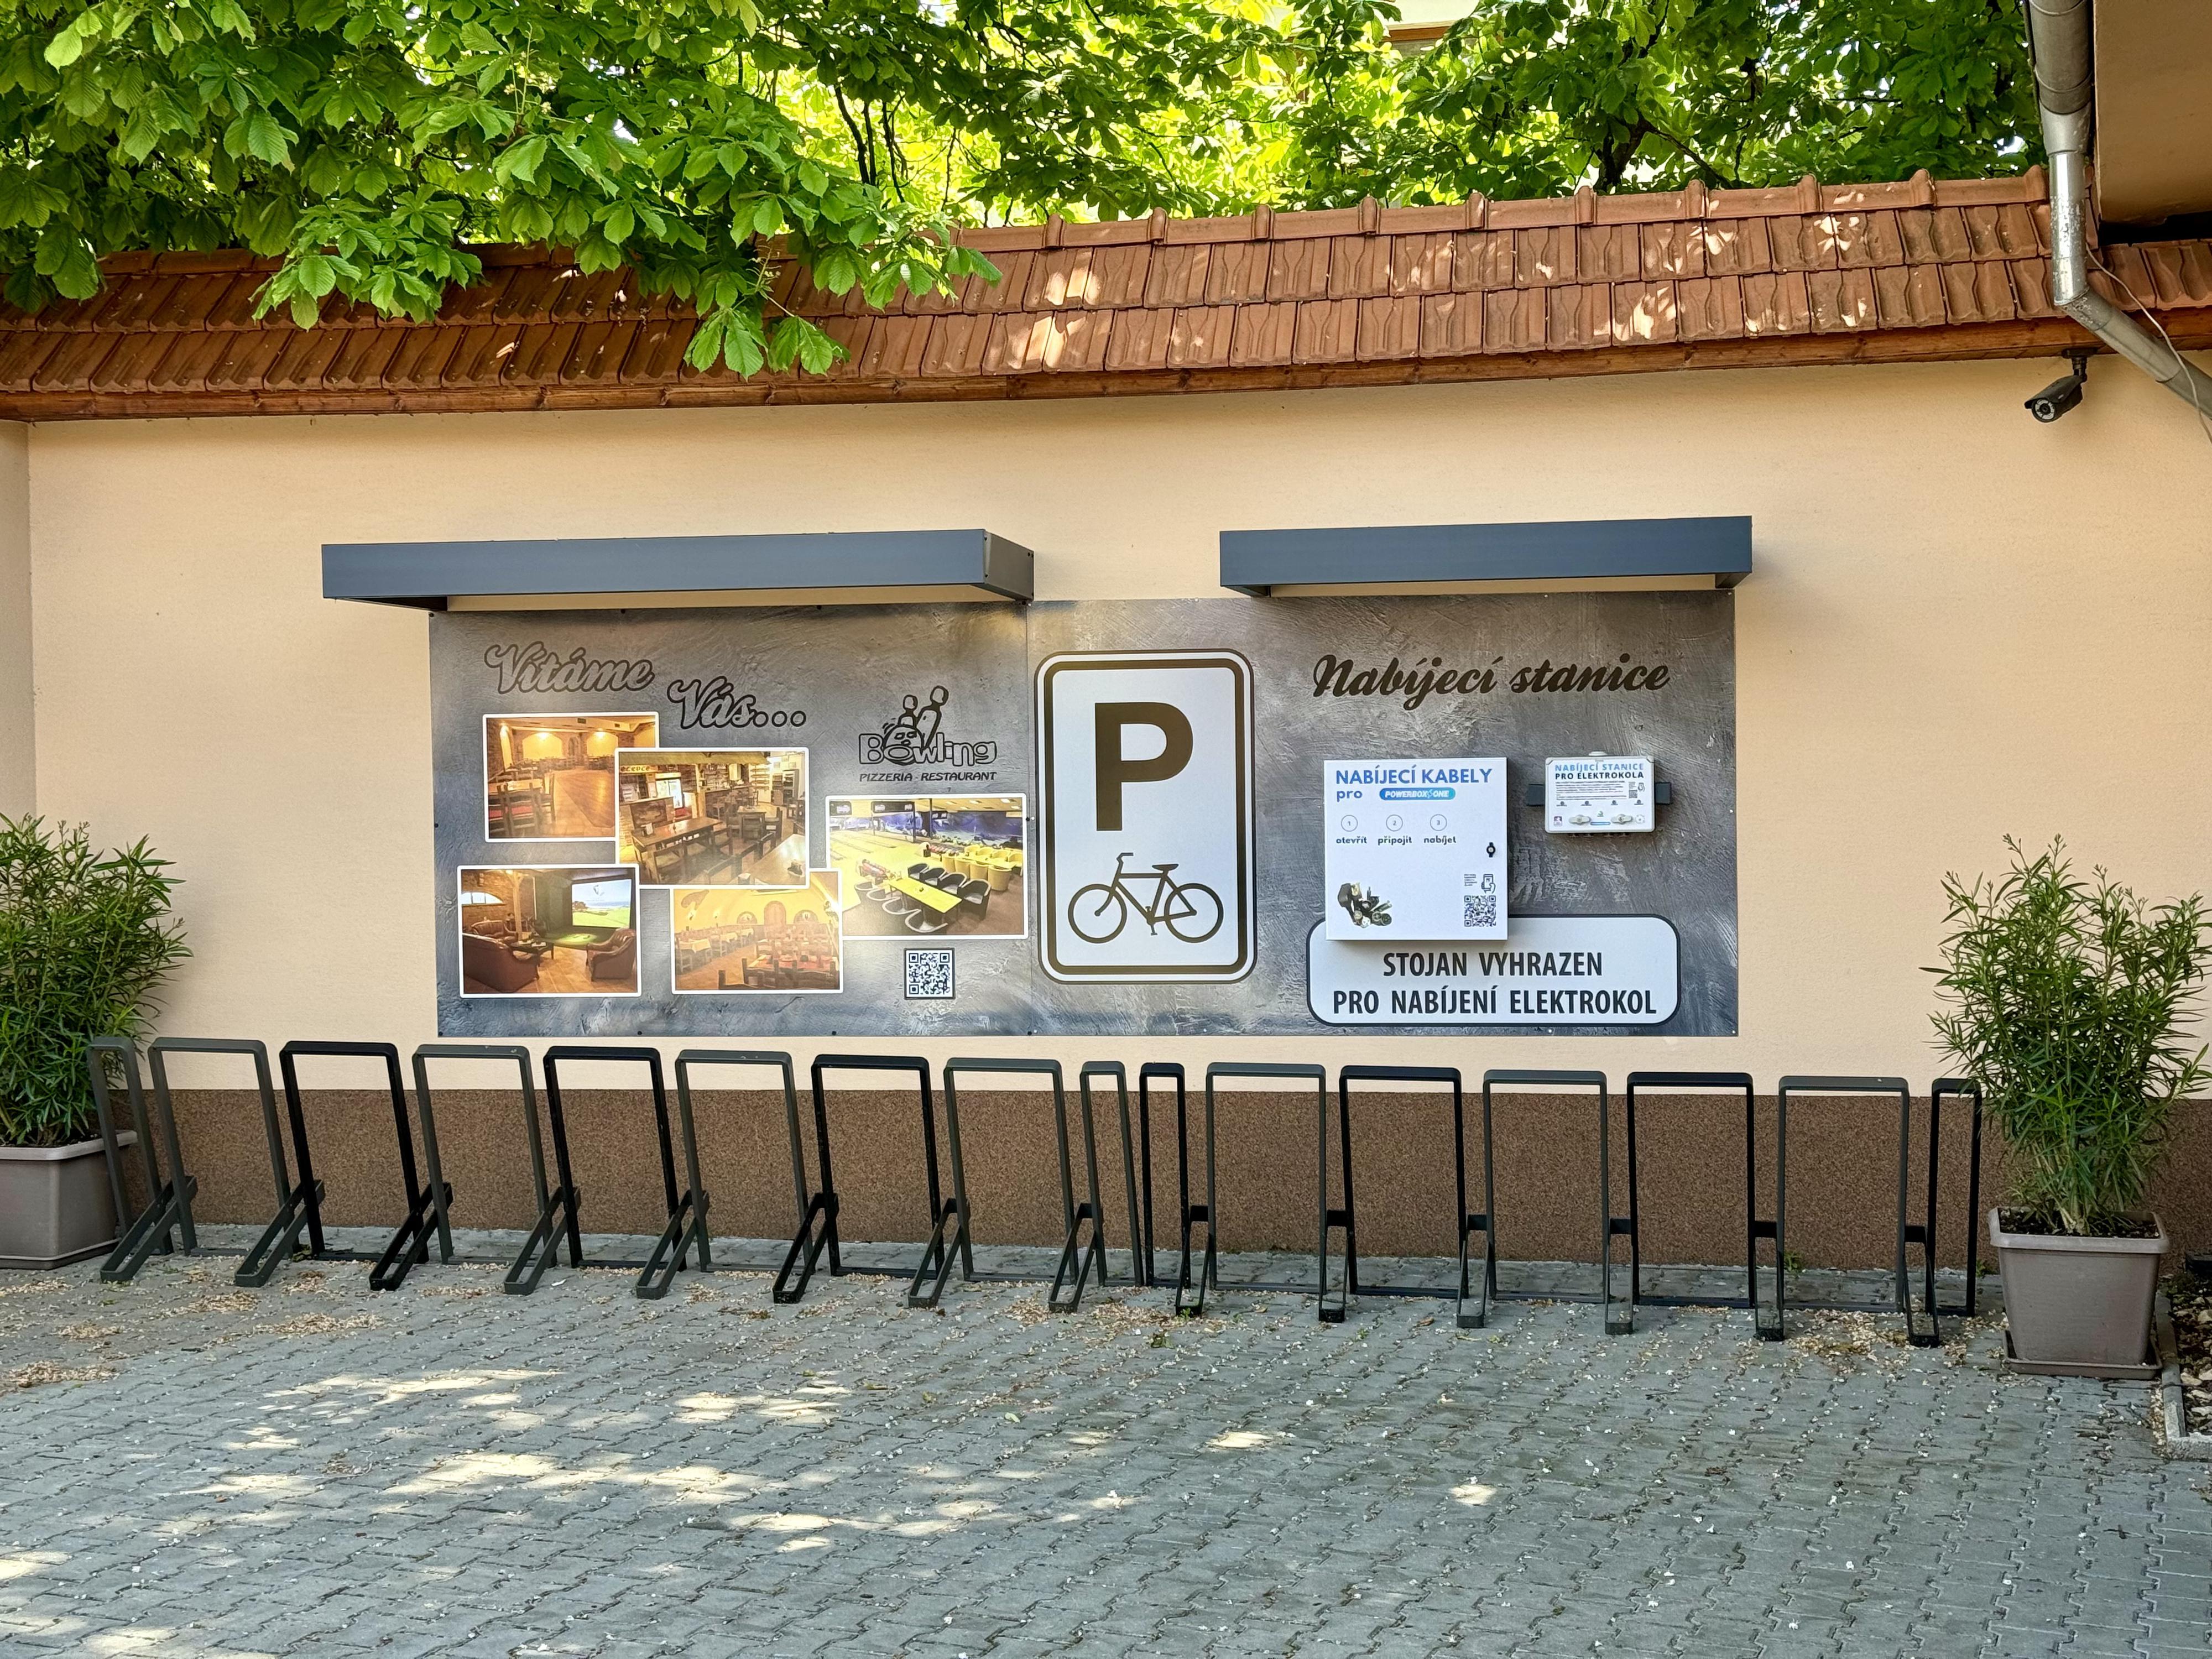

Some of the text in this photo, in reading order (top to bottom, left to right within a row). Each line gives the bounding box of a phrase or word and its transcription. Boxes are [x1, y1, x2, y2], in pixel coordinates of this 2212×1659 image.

[484, 641, 655, 694] Vítáme
[1313, 653, 1671, 711] Nabíjecí stanice
[859, 773, 912, 782] PIZZERIA
[921, 772, 997, 781] RESTAURANT
[1095, 702, 1193, 831] P
[1336, 764, 1492, 784] NABÍJECÍ KABELY
[1555, 762, 1644, 772] NABÍJECÍ STANICE
[1337, 790, 1363, 802] pro
[1383, 952, 1603, 977] STOJAN VYHRAZEN
[1333, 985, 1657, 1014] PRO NABÍJENÍ ELEKTROKOL
